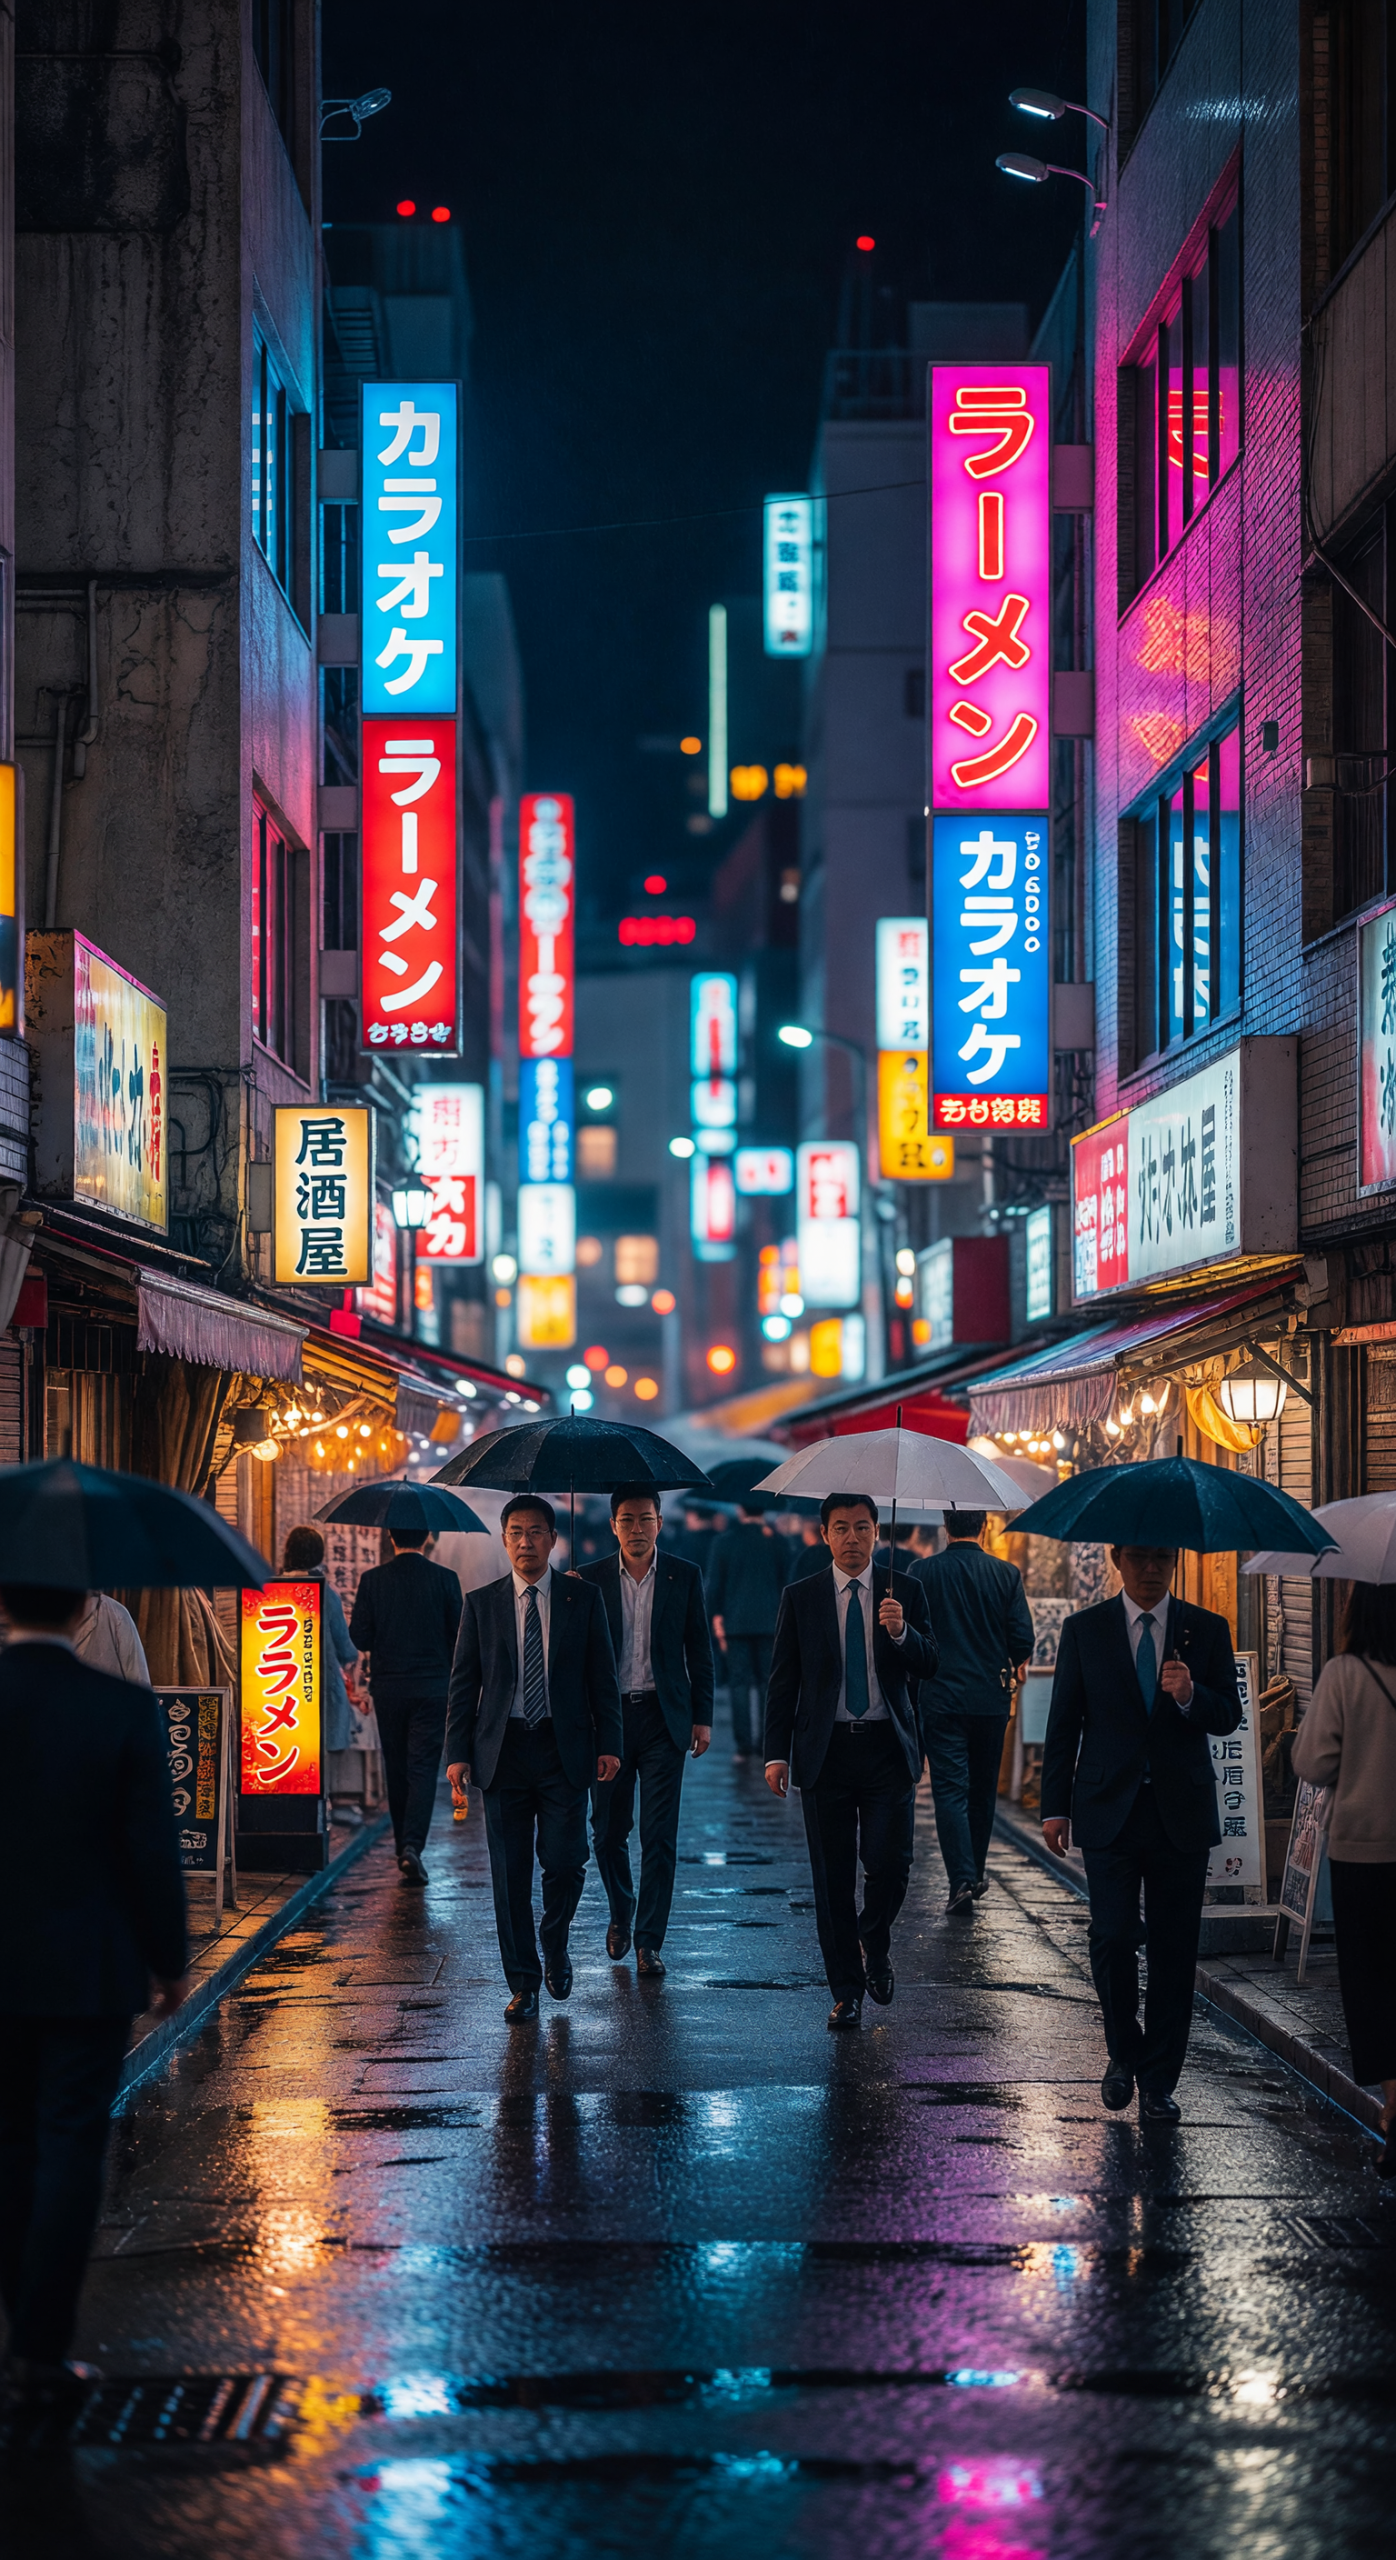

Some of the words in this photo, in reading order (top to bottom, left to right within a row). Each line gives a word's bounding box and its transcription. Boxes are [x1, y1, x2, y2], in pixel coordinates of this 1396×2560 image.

[375, 401, 444, 696] カラオケ
[949, 387, 1037, 788] ラーメン
[378, 739, 444, 1013] ラーメン
[957, 831, 1021, 1085] カラオケ
[295, 1117, 348, 1275] 居酒屋
[255, 1604, 301, 1784] ララメン
